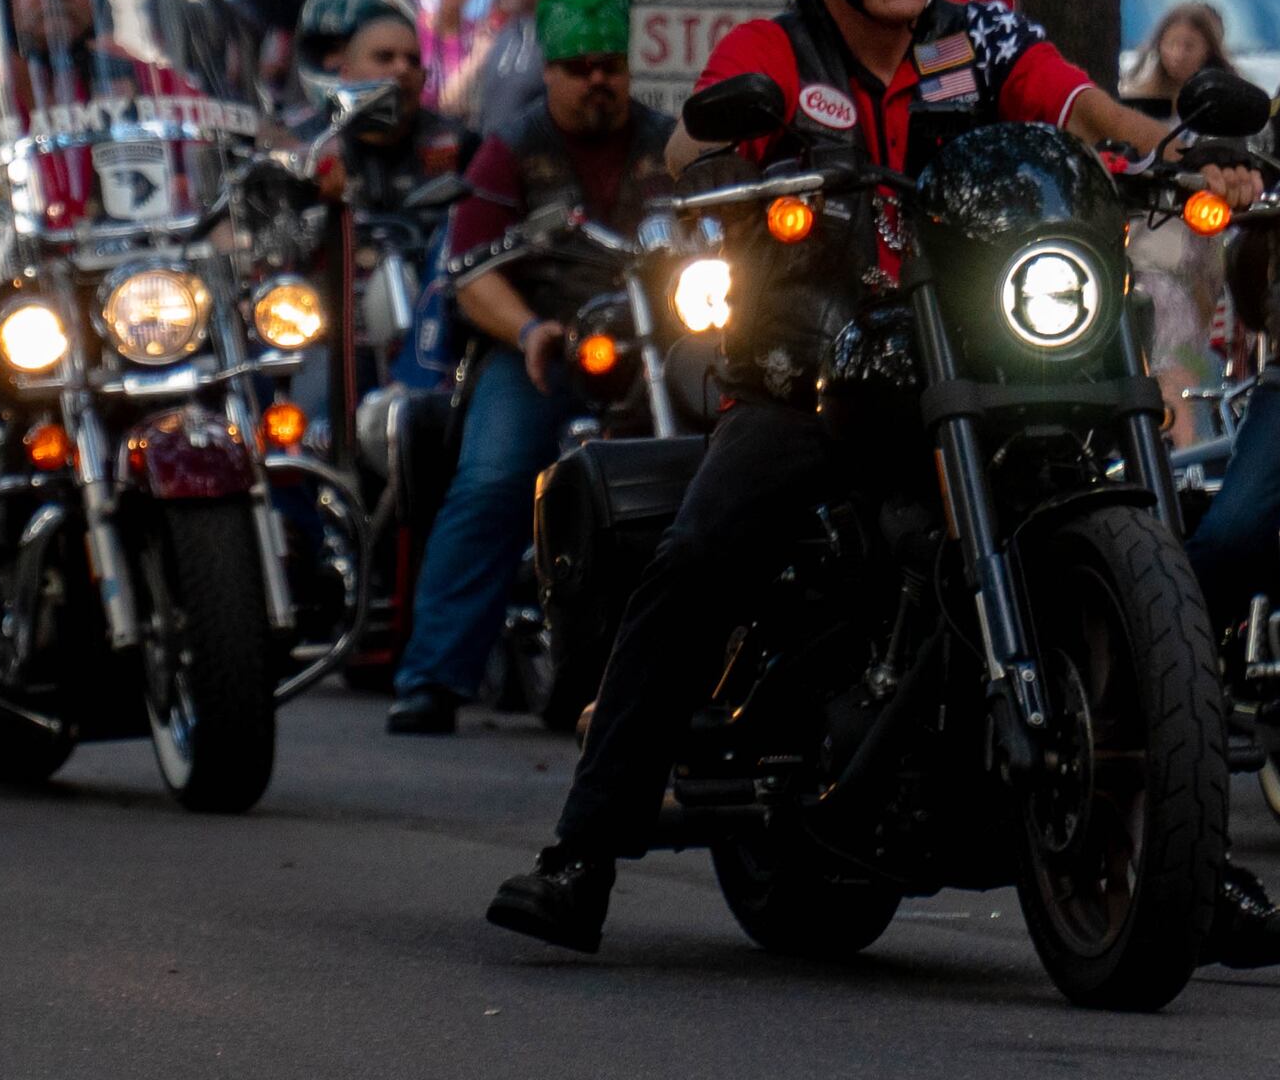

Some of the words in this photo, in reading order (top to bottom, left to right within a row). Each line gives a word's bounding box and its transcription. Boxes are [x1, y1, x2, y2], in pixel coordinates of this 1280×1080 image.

[29, 96, 128, 135] ARMY
[137, 95, 258, 137] RETIRED
[805, 88, 851, 122] Coors
